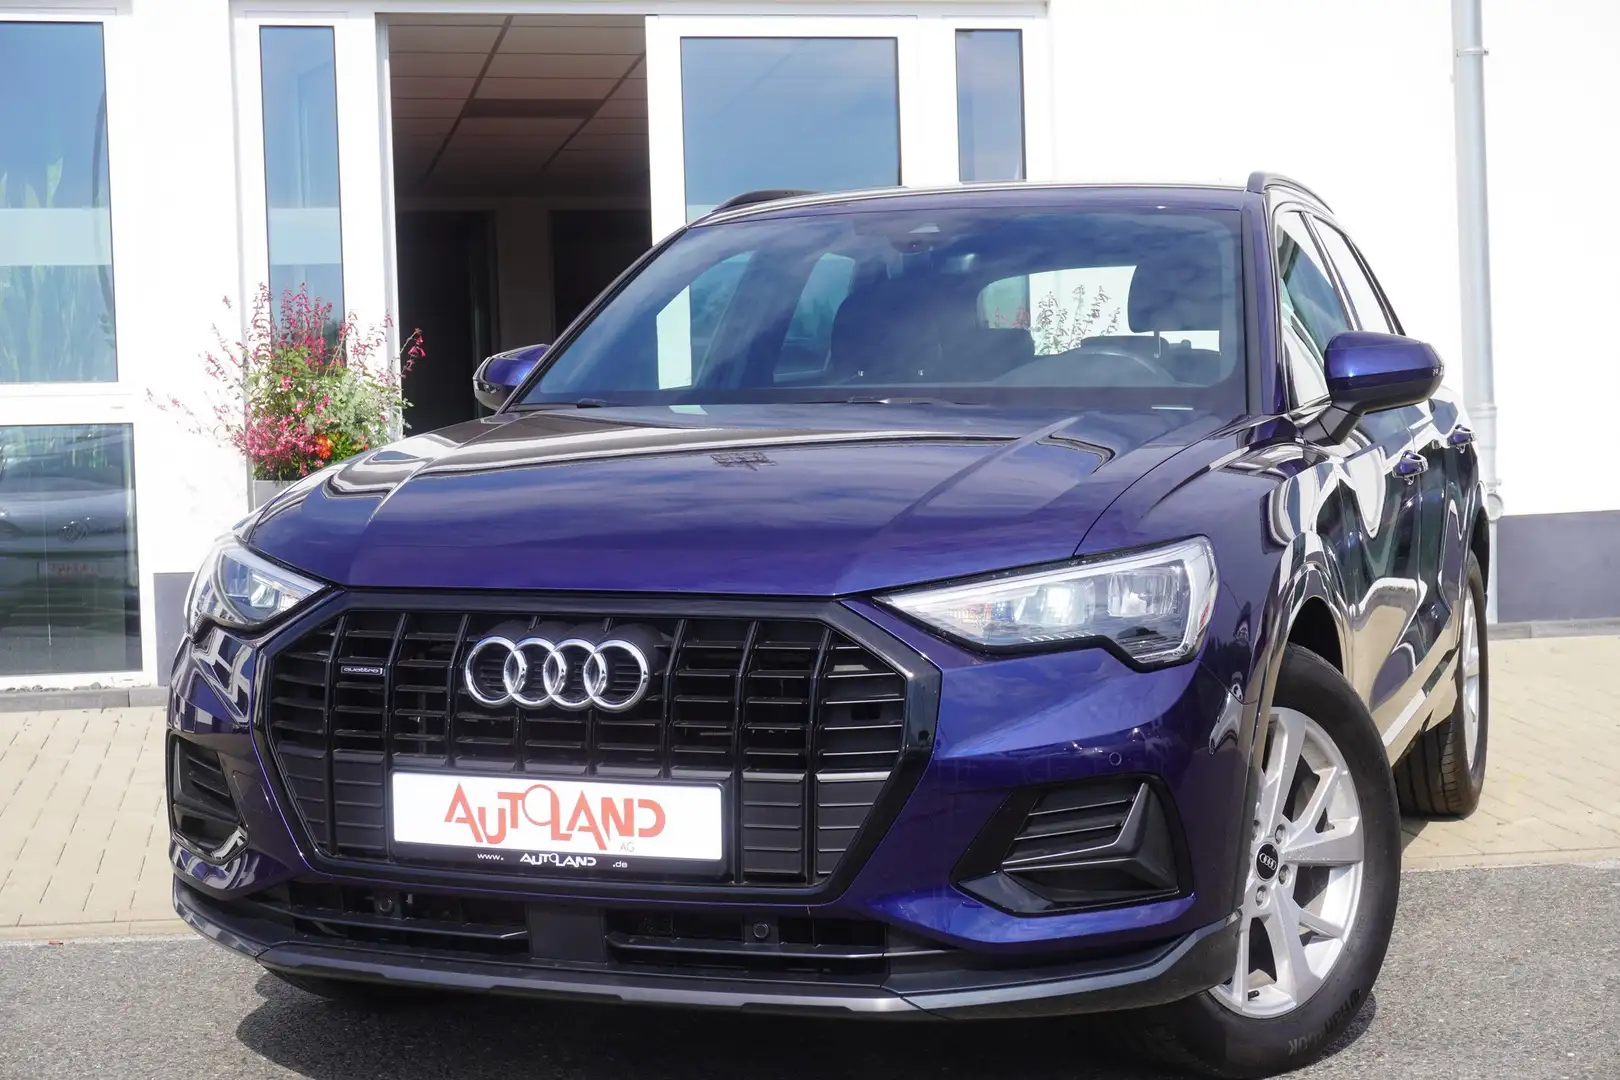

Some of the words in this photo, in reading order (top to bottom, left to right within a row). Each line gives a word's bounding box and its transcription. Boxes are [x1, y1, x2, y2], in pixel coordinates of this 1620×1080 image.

[619, 841, 635, 852] AG
[477, 853, 504, 861] www.
[612, 860, 628, 868] .de
